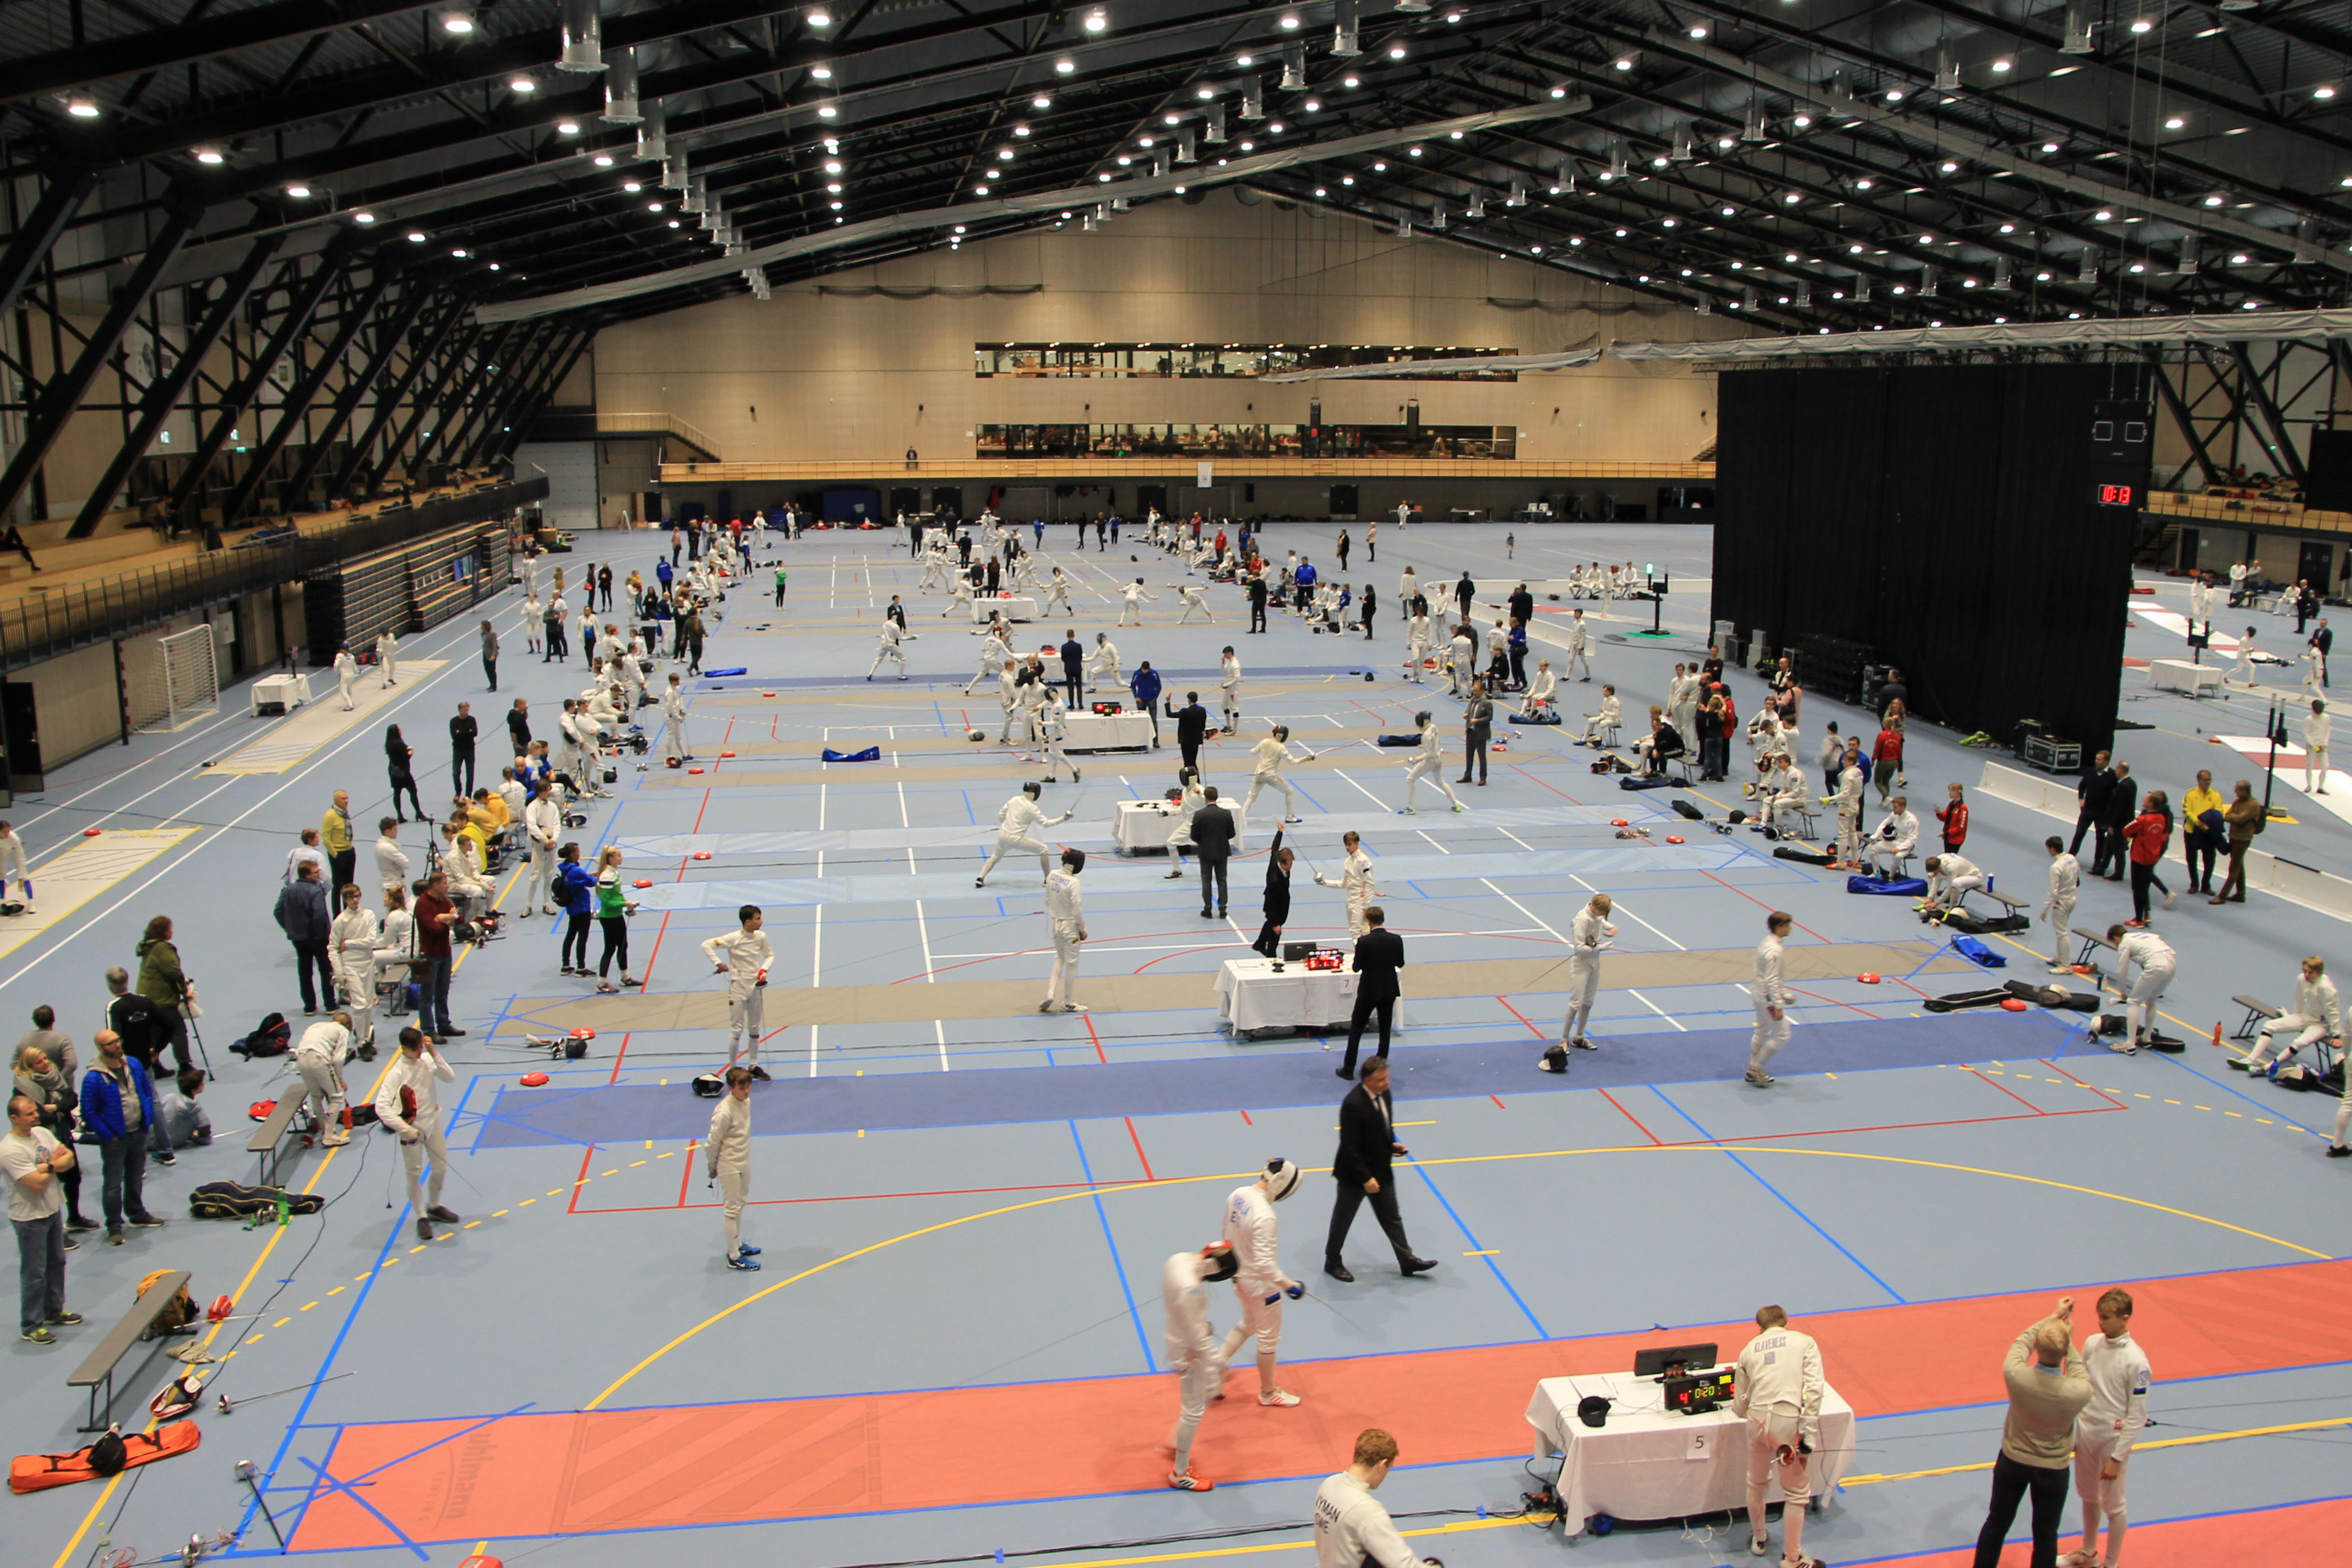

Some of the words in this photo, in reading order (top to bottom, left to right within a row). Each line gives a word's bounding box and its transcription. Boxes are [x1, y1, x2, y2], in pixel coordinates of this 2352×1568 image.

[2102, 486, 2131, 504] 10:13
[1332, 959, 1340, 967] 2
[1344, 979, 1349, 988] 7
[1754, 1336, 1787, 1353] KLAVENESS
[1679, 1392, 1689, 1404] 4
[1695, 1385, 1715, 1398] 0:20
[1695, 1435, 1704, 1449] 5
[443, 1433, 498, 1520] uhlmann
